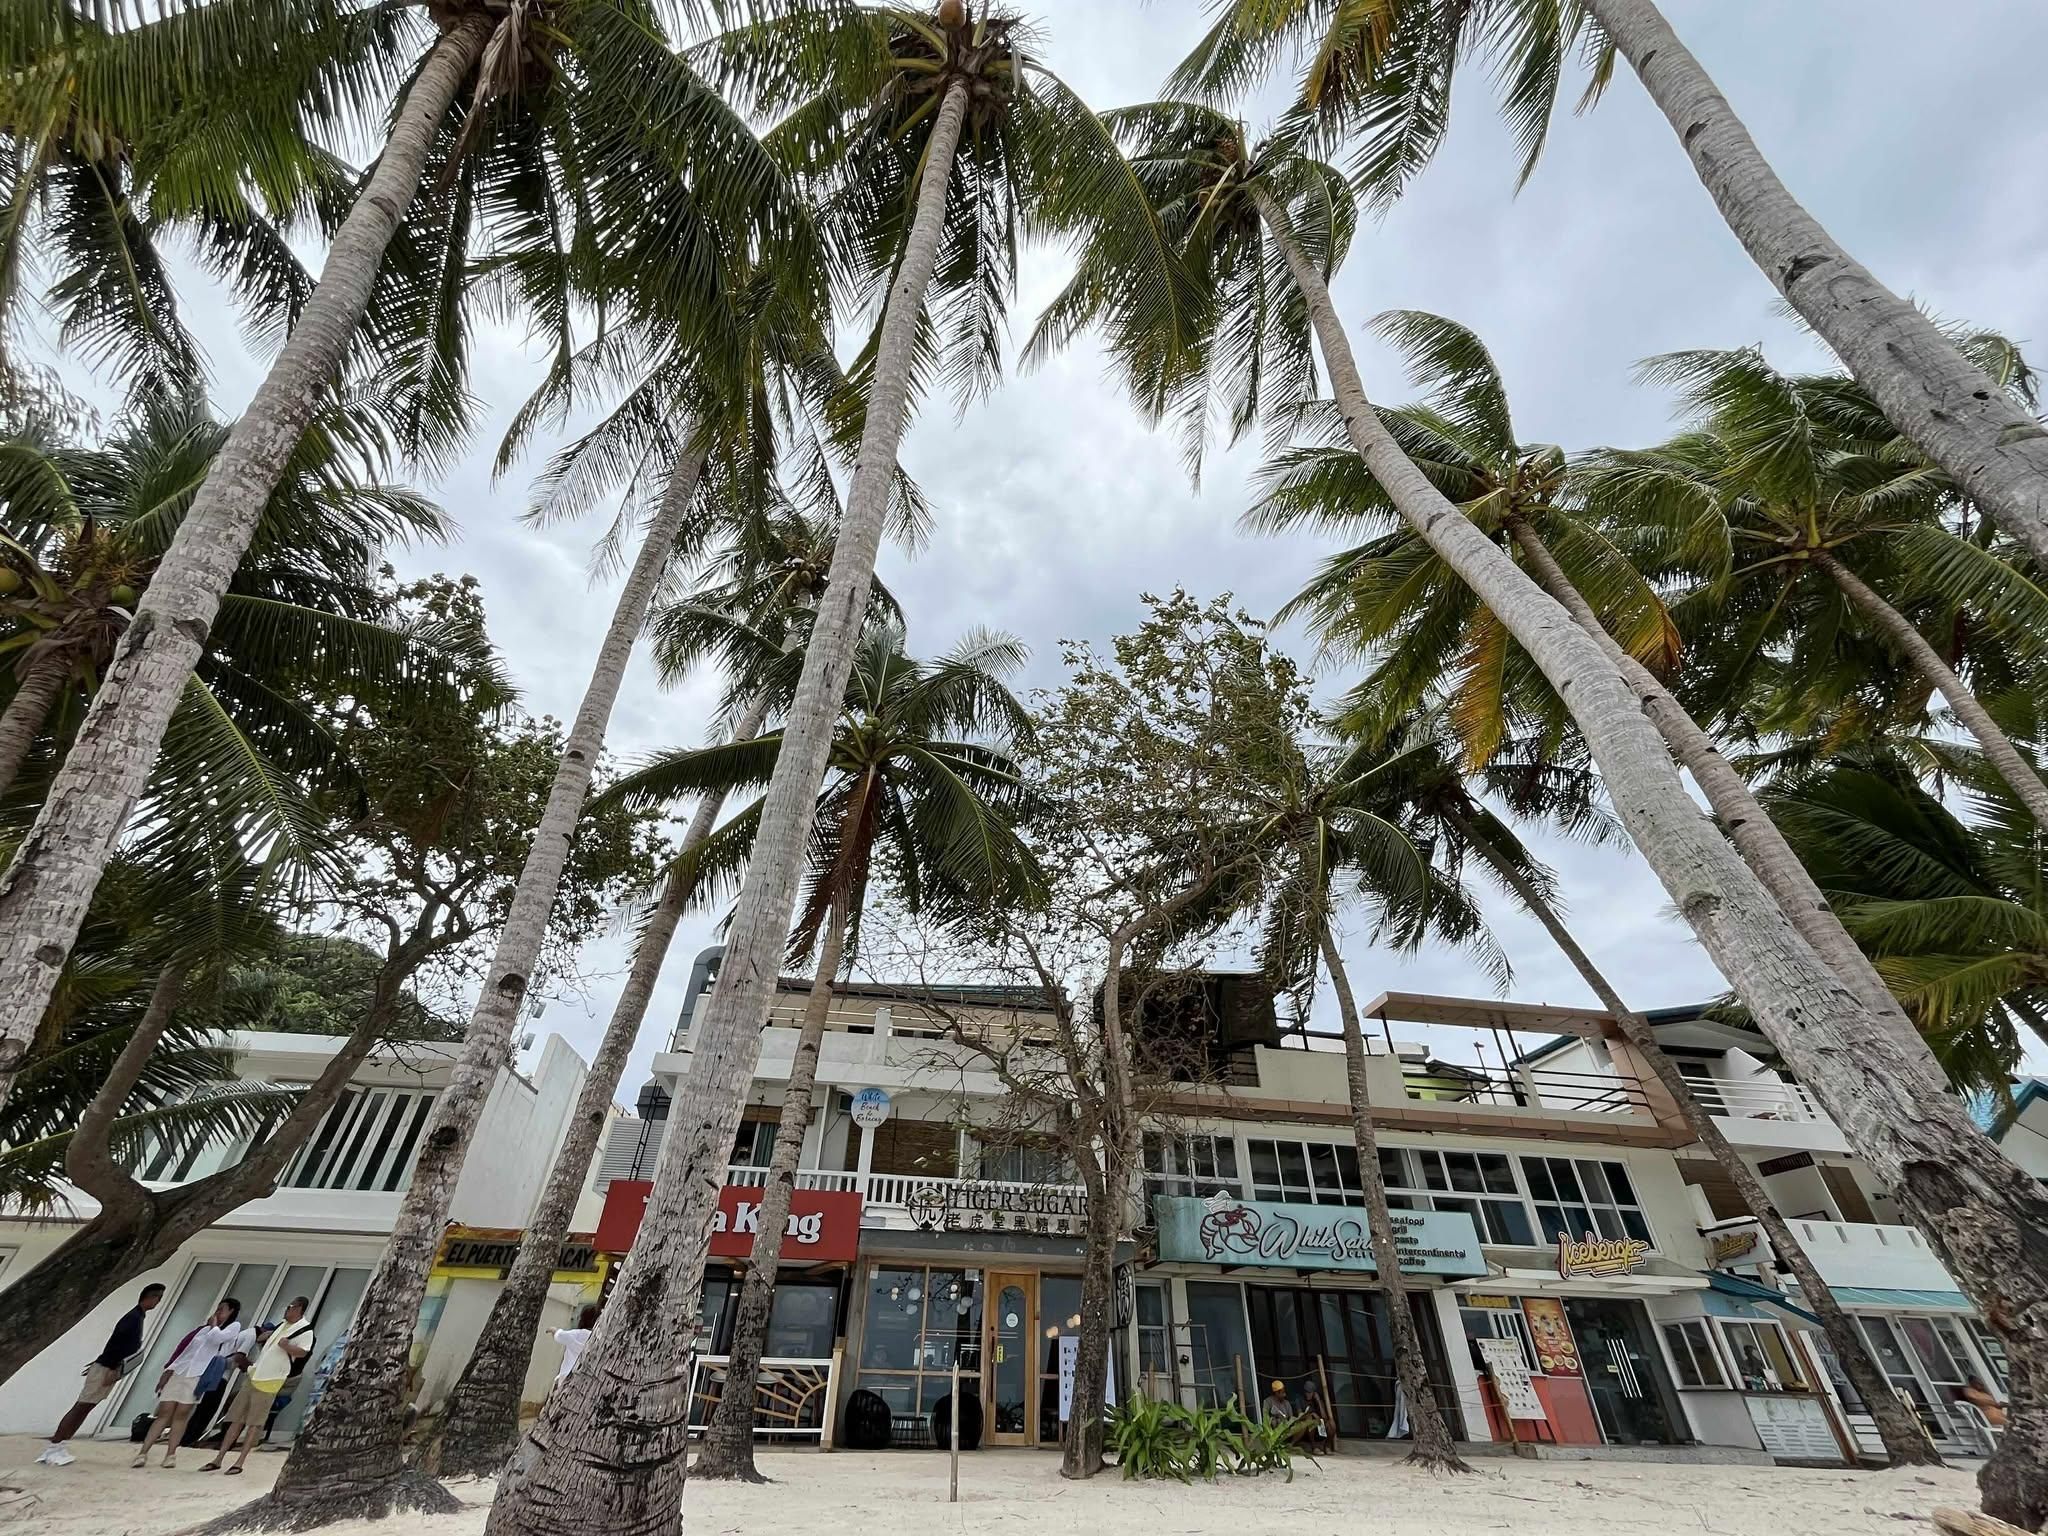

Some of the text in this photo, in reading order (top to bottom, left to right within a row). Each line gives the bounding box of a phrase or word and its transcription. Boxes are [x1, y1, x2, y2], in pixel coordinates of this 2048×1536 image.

[950, 1189, 1088, 1216] TIGER SUGAR
[732, 1202, 824, 1244] Kng
[1390, 1216, 1425, 1226] seafood
[1391, 1225, 1408, 1235] grill
[1394, 1236, 1419, 1245] pasta
[446, 1243, 463, 1262] EL
[465, 1244, 516, 1264] PUERT
[1396, 1247, 1466, 1259] intercontinental
[1398, 1257, 1426, 1266] coffee
